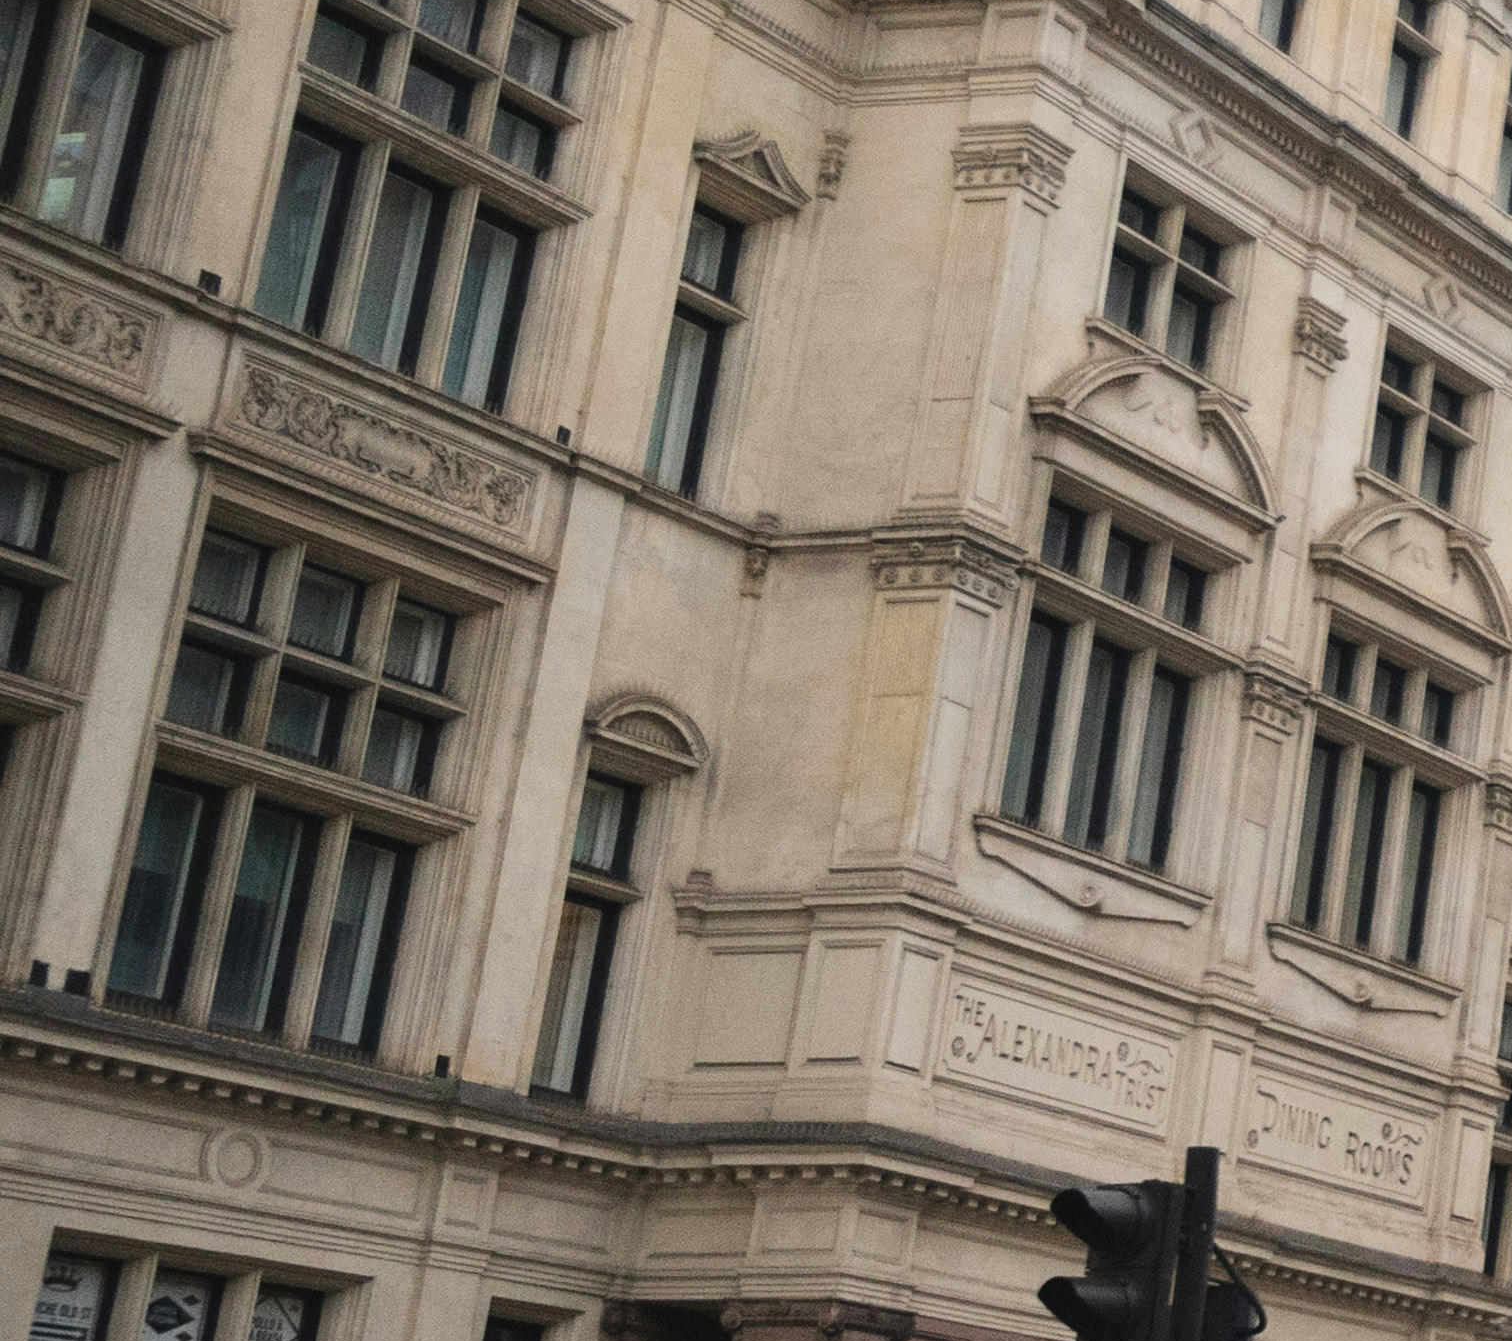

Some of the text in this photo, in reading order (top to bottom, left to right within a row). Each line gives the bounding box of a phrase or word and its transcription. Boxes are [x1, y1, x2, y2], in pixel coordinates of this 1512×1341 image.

[954, 994, 984, 1028] THE
[967, 1014, 1115, 1090] ALEXANDRA
[1114, 1070, 1166, 1111] TRUST
[1257, 1085, 1332, 1149] DINING
[1345, 1130, 1415, 1186] ROOMS
